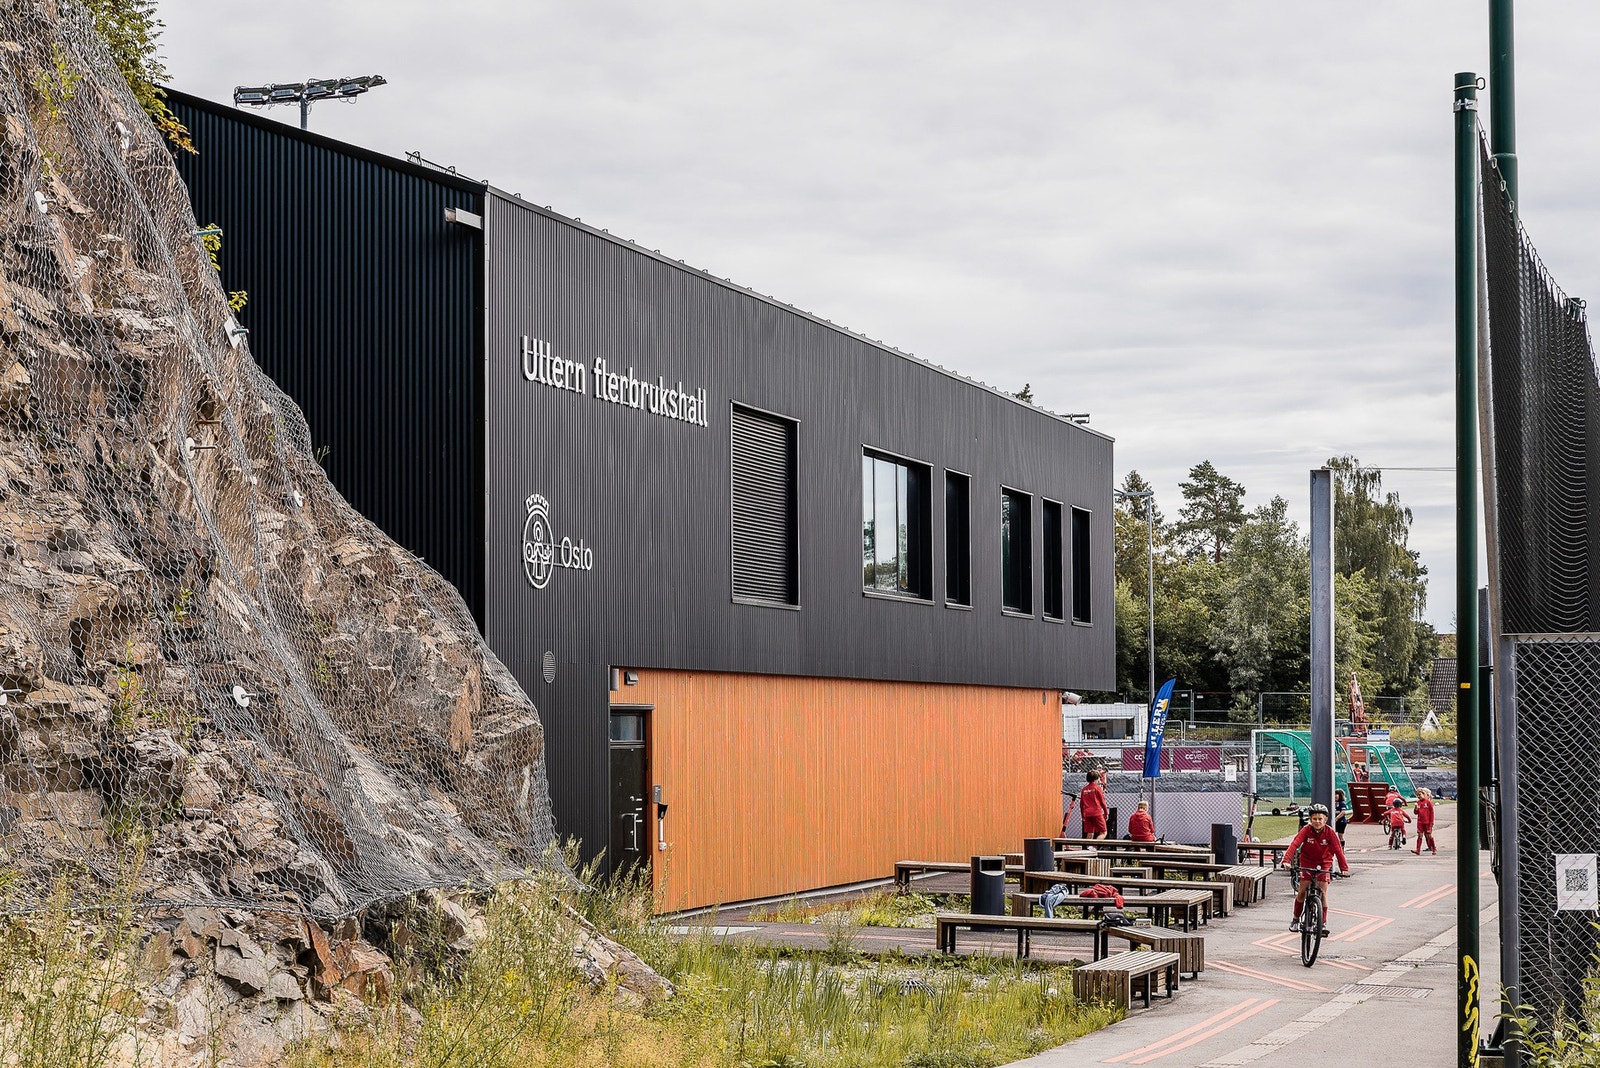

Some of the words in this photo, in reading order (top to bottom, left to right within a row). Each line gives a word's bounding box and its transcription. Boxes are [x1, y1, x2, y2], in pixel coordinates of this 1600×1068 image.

[522, 335, 586, 394] Ullern
[594, 357, 708, 427] flerbrukshall
[561, 536, 593, 570] Oslo
